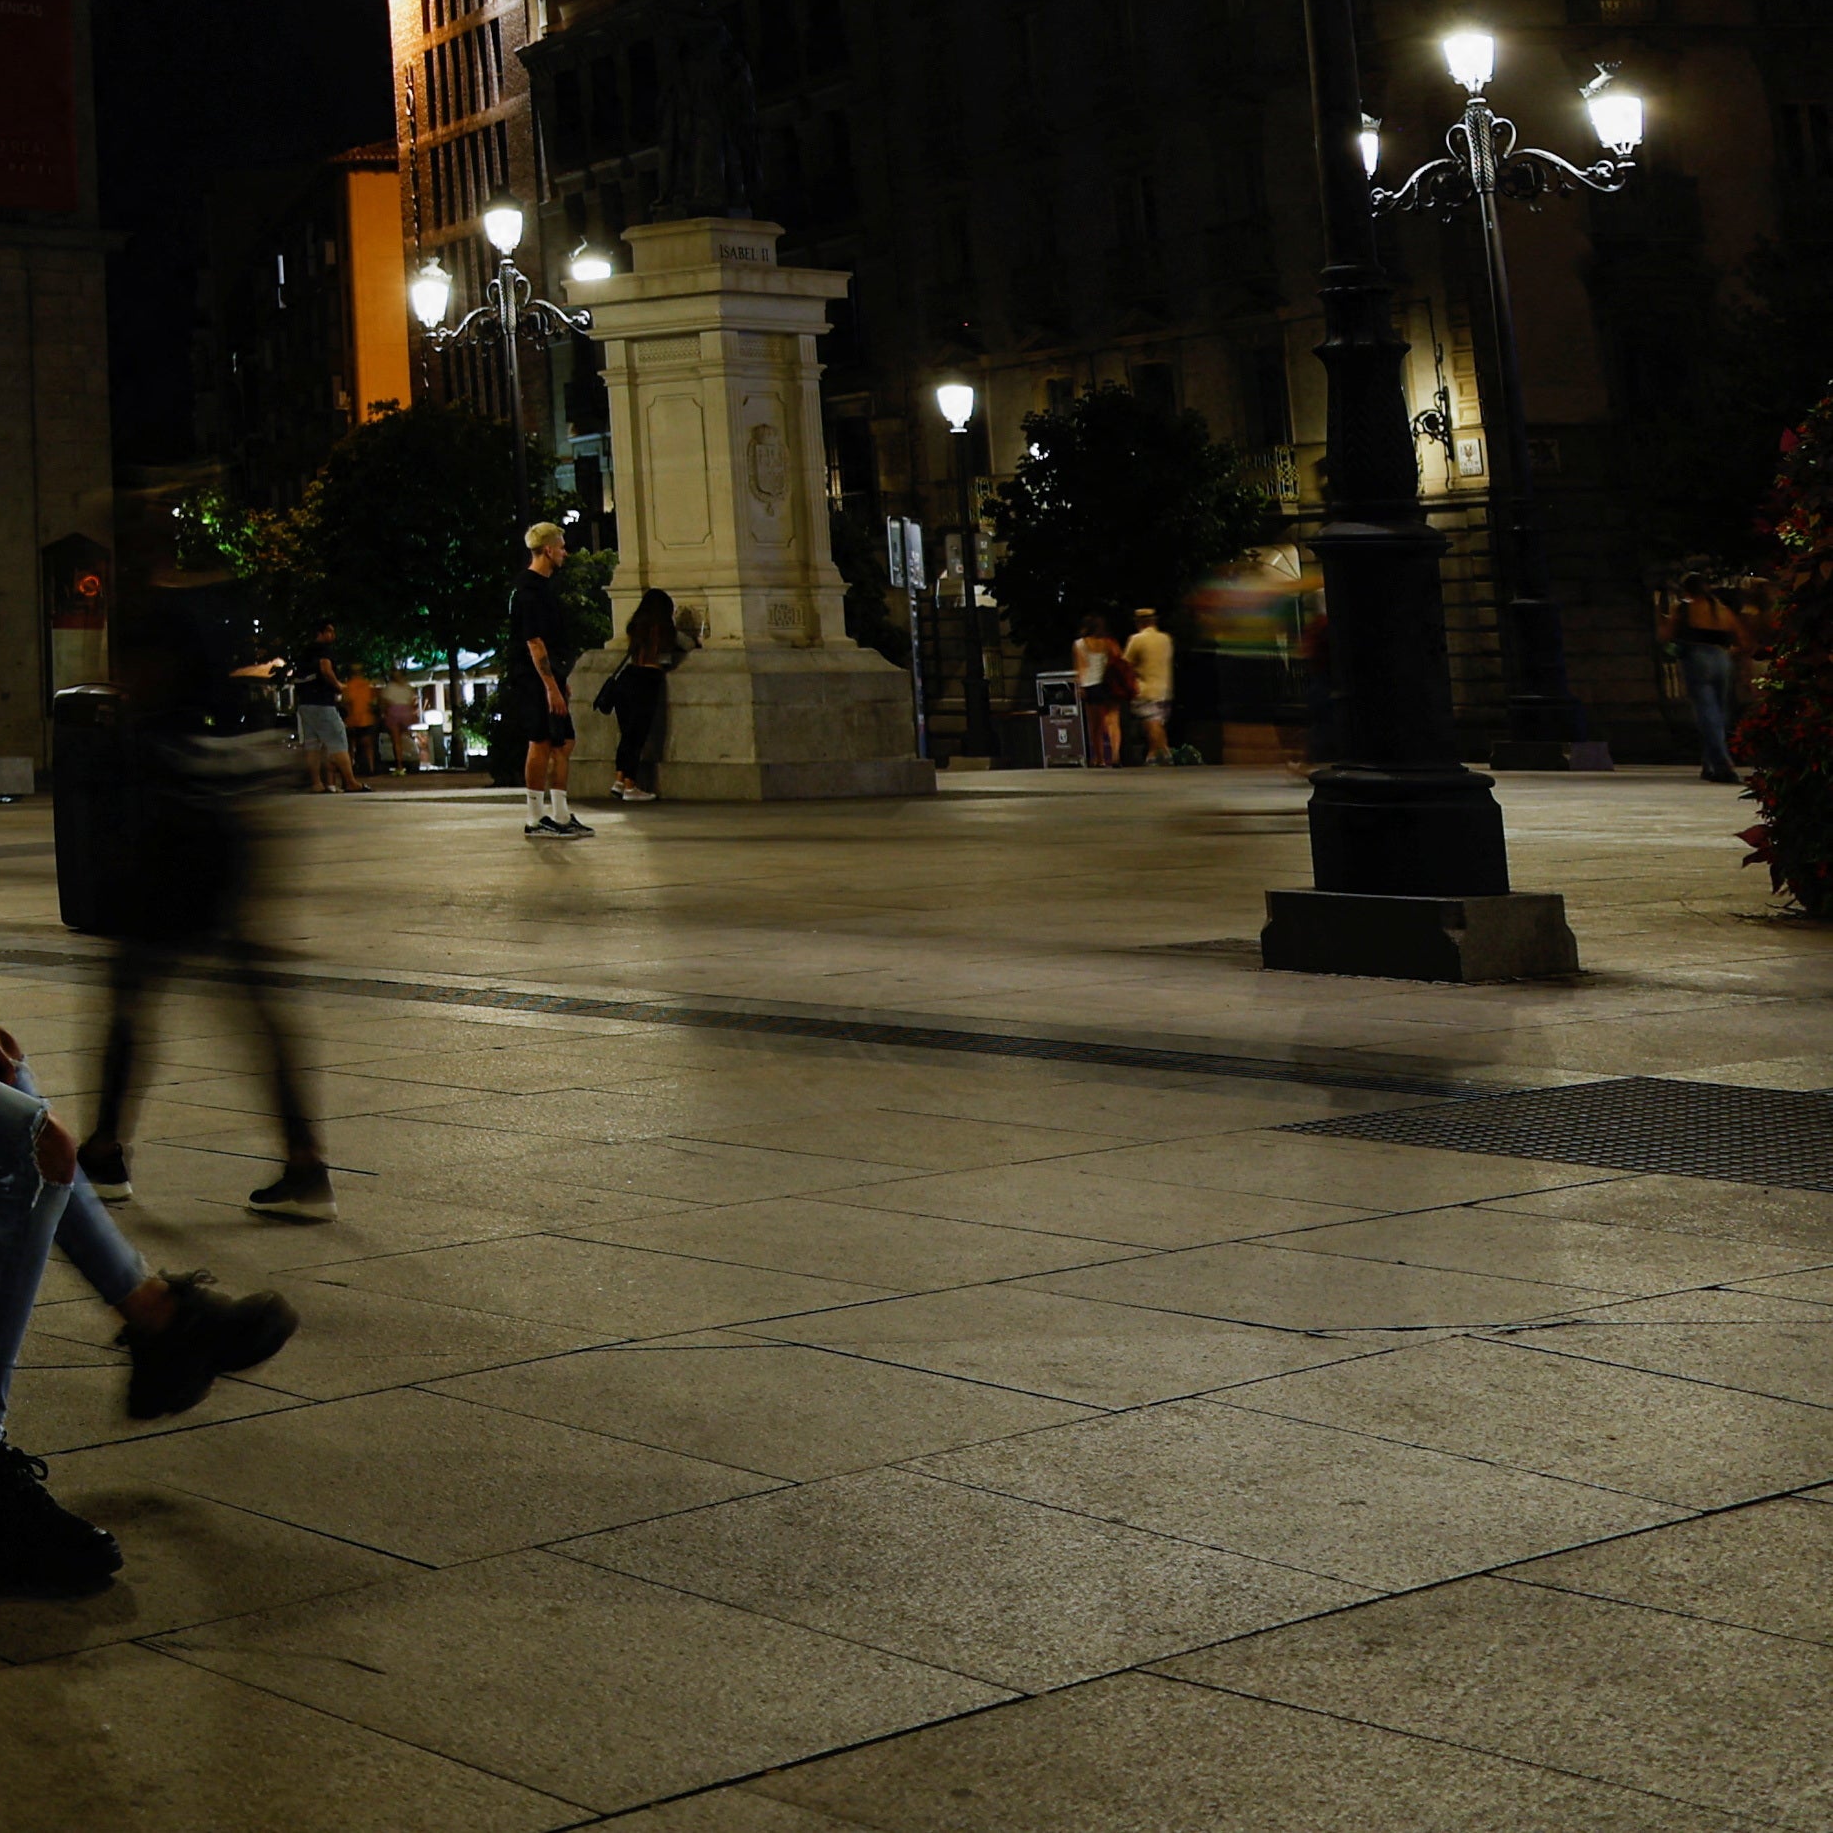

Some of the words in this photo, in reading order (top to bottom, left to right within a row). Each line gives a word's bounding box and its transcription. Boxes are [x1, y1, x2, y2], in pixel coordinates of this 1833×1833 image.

[11, 140, 51, 156] REAL
[719, 244, 757, 261] ISABEL
[762, 248, 769, 262] II
